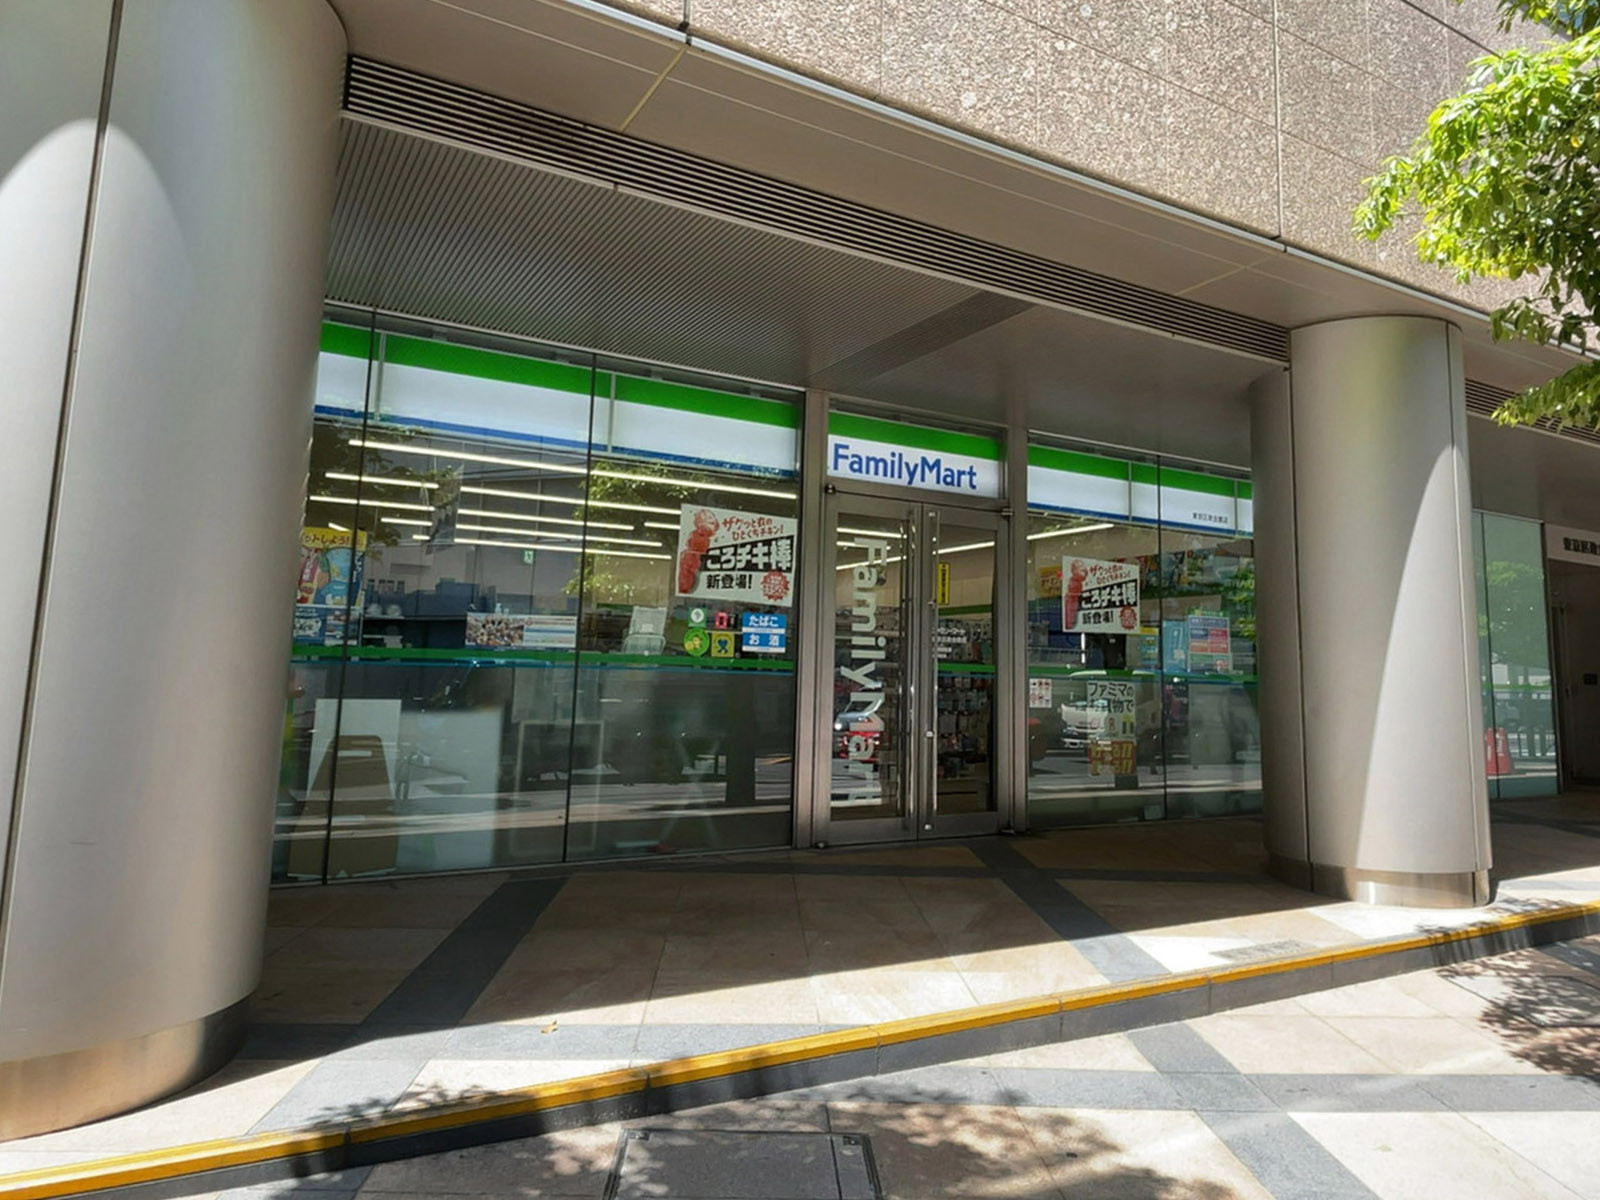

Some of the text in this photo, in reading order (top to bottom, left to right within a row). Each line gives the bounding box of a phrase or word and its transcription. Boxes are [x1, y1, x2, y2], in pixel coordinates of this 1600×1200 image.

[833, 443, 976, 489] FamilyMart
[706, 538, 791, 570] ころチキ棒
[706, 573, 753, 590] 新登場!
[1081, 582, 1136, 609] ころチキ棒
[749, 615, 779, 628] たばこ
[1082, 610, 1114, 624] 新登場!
[840, 538, 887, 804] FamilyMart
[1088, 682, 1134, 697] ファミマの
